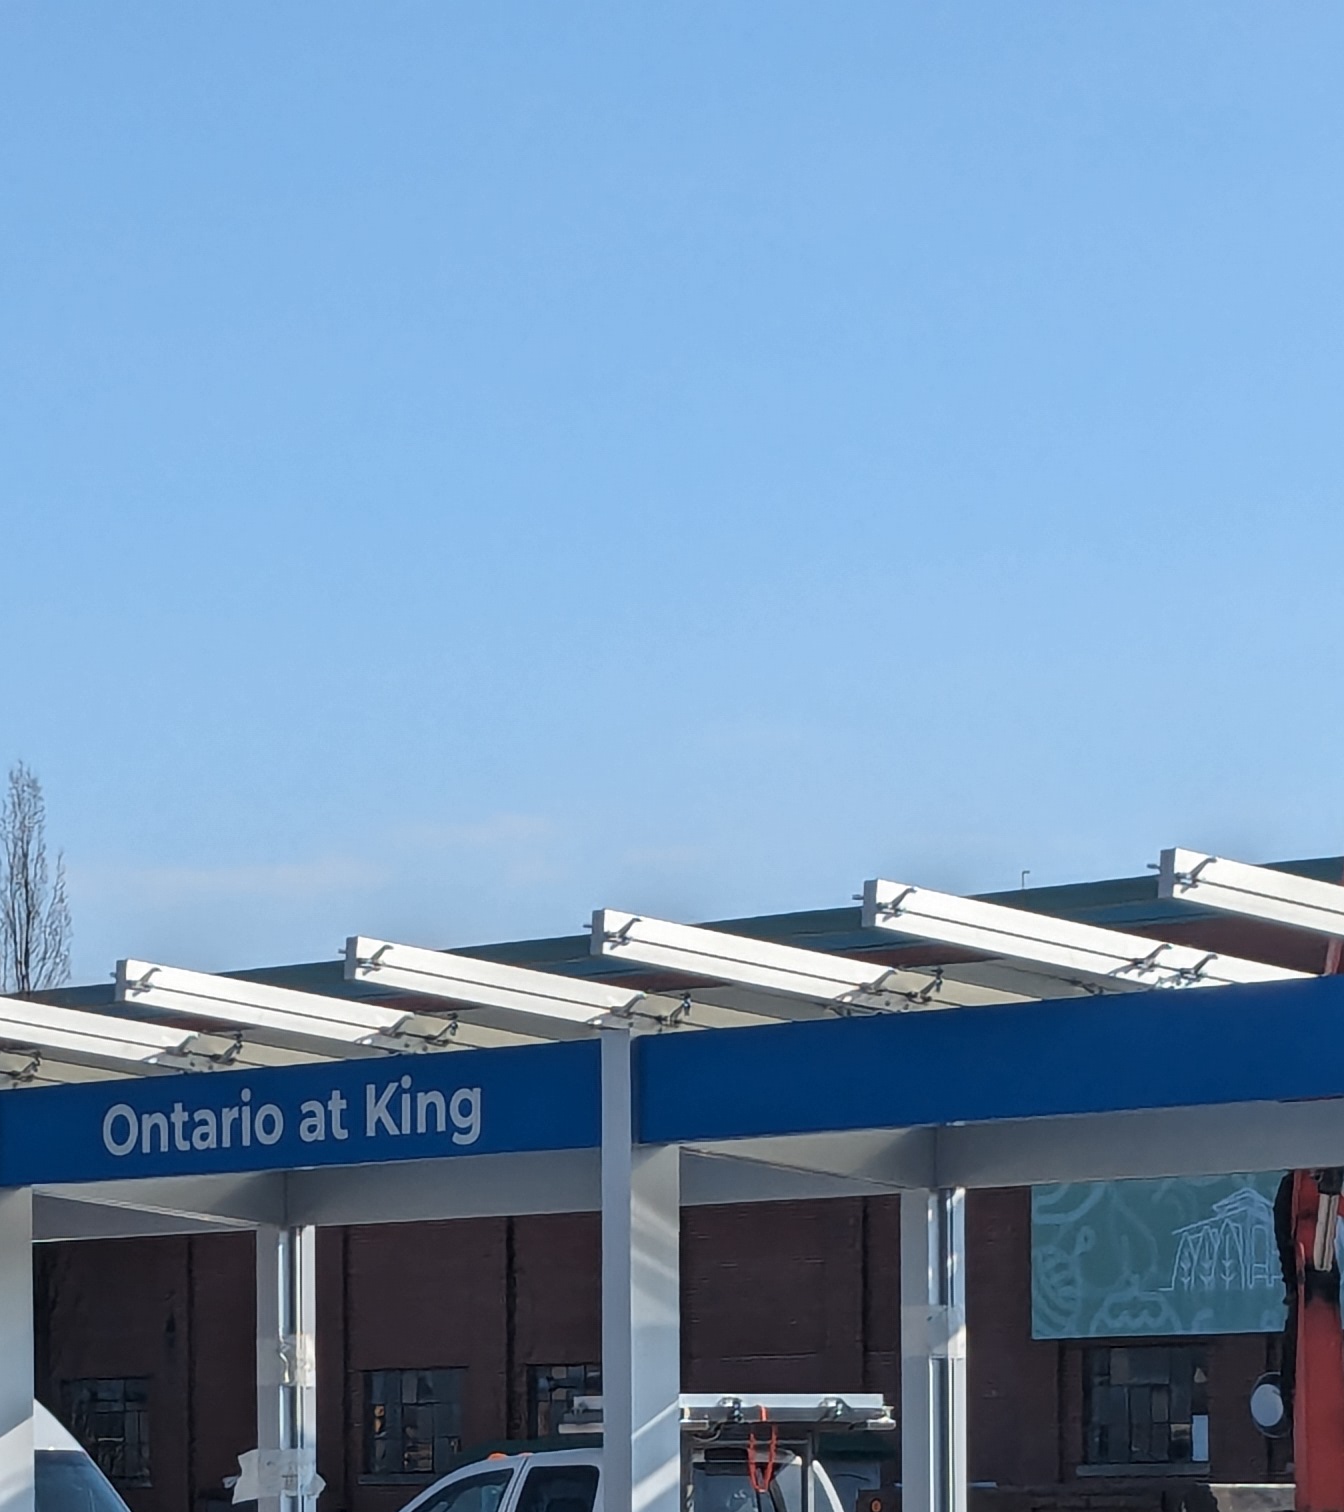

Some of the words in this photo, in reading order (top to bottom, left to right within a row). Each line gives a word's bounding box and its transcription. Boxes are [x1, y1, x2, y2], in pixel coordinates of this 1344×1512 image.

[102, 1087, 284, 1156] Ontario
[299, 1089, 349, 1143] at
[365, 1074, 482, 1146] King
